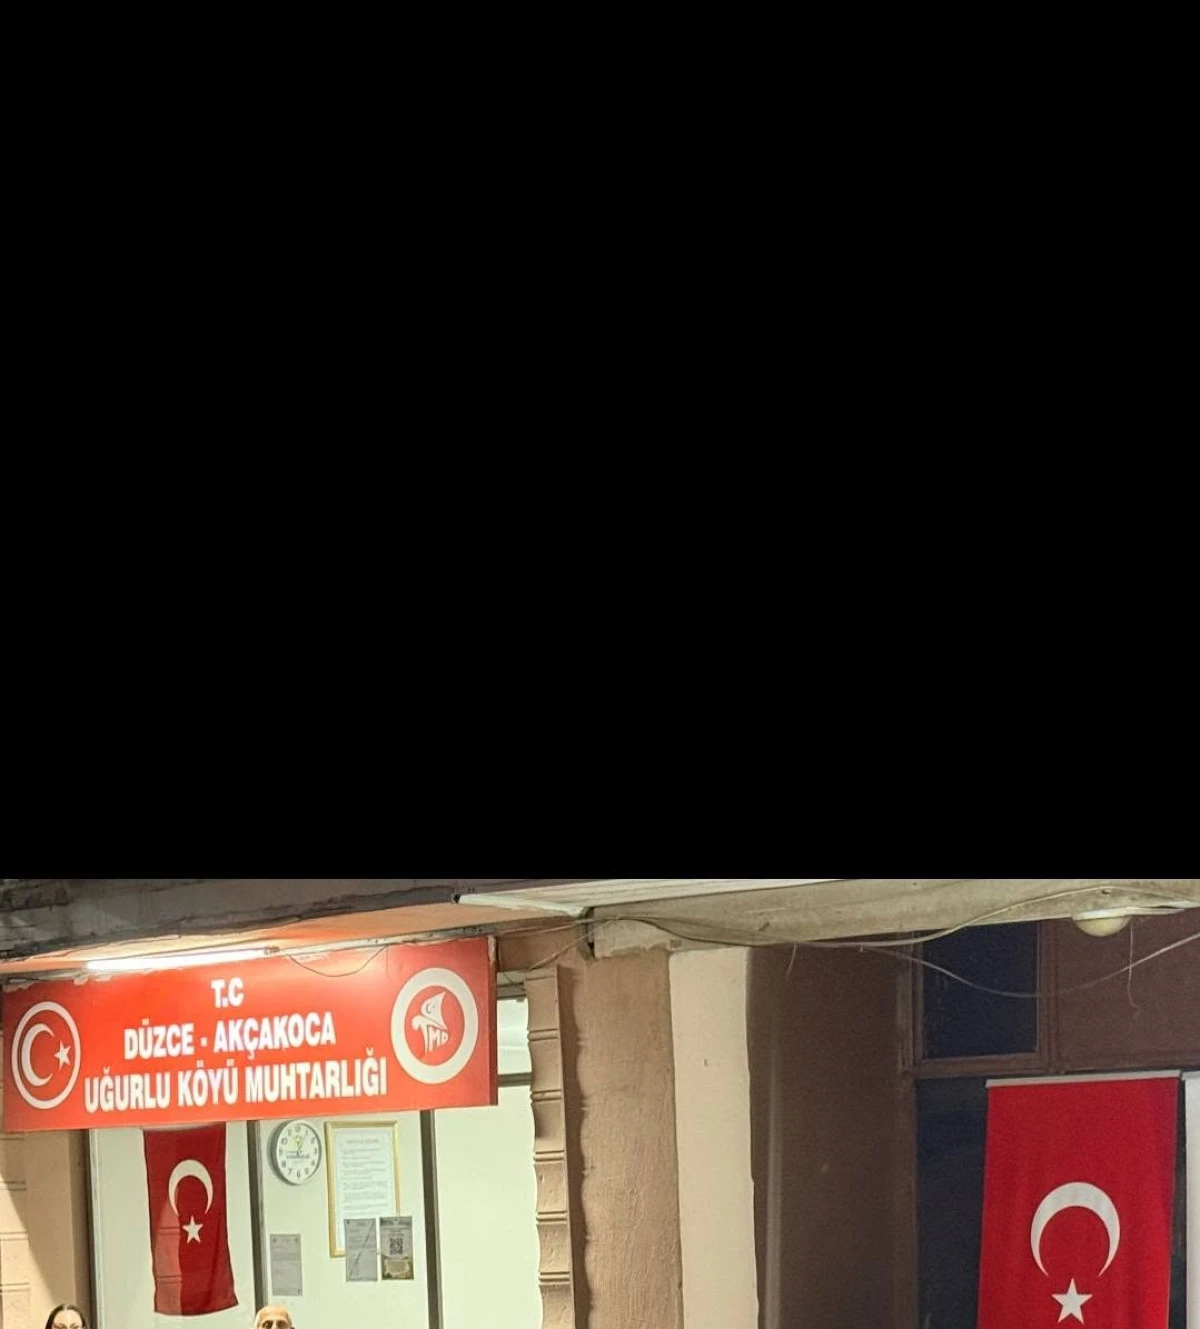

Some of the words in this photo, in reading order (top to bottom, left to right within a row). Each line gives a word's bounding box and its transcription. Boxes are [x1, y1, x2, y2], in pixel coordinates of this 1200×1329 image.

[211, 977, 245, 1007] T.C
[123, 1018, 195, 1060] DÜZCE
[213, 1012, 337, 1059] AKÇAKOCA
[85, 1071, 171, 1113] UĞURLU
[178, 1059, 239, 1108] KÖYÜ
[245, 1049, 388, 1103] MUHTARLIĞI
